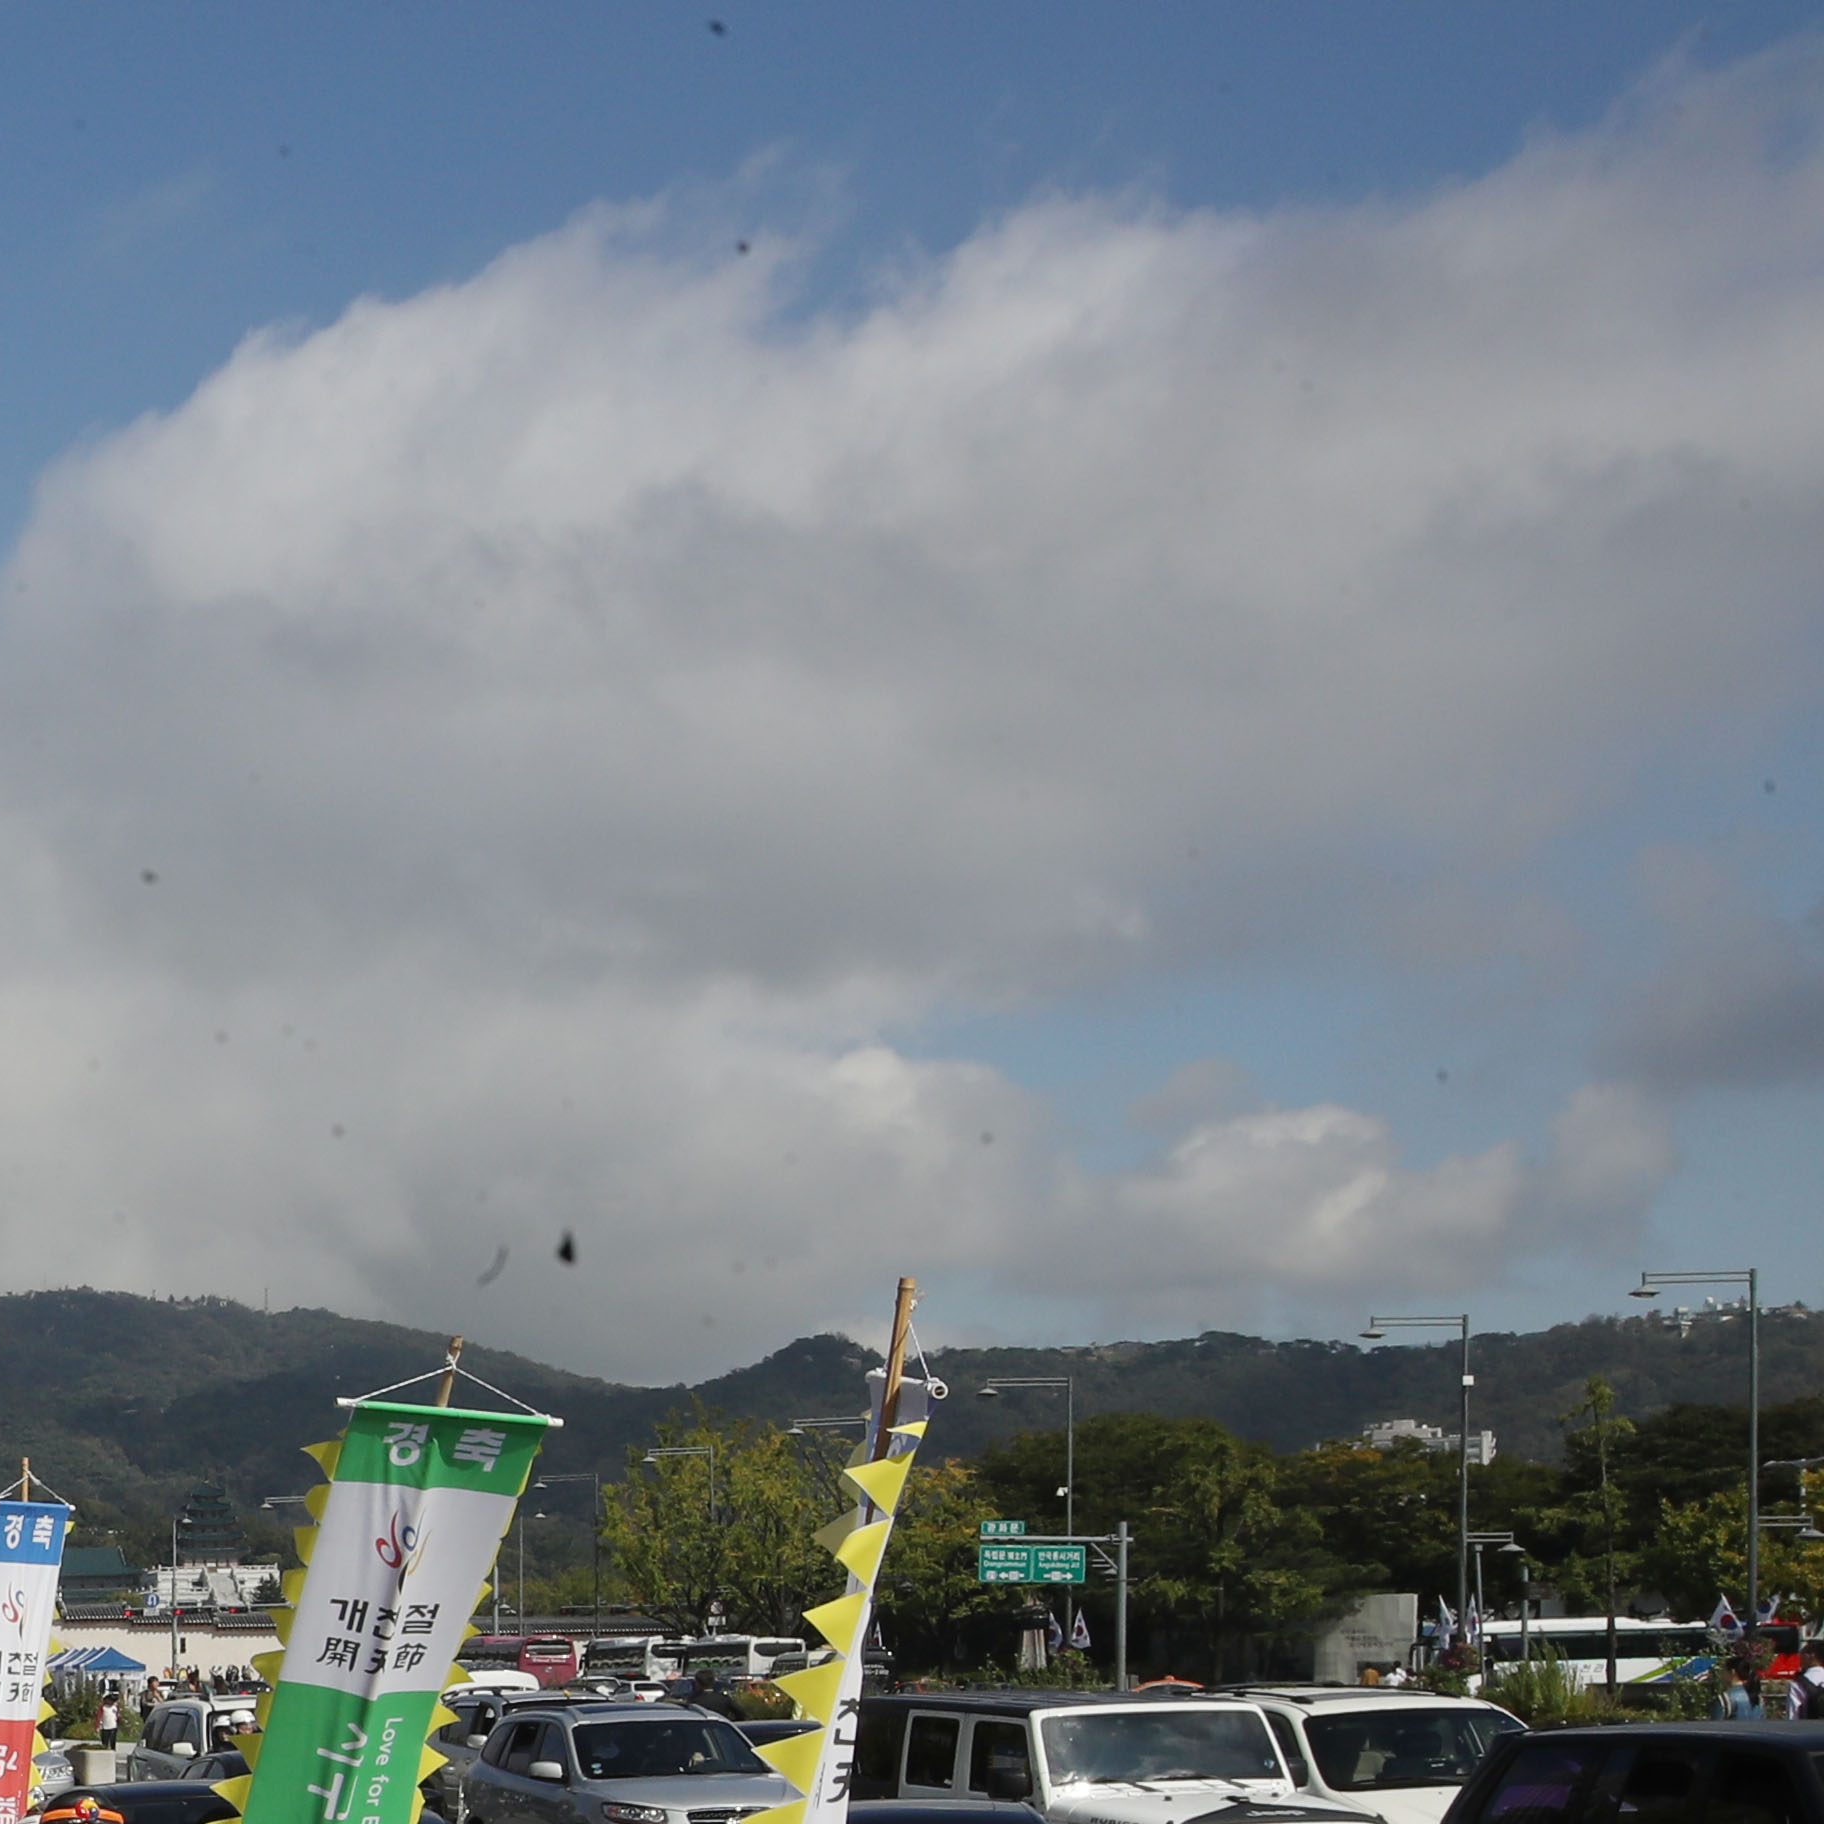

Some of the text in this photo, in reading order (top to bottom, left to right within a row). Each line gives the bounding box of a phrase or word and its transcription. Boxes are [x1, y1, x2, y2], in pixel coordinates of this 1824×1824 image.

[330, 1598, 441, 1642] 개천절
[375, 1717, 404, 1766] Love
[365, 1773, 390, 1807] for
